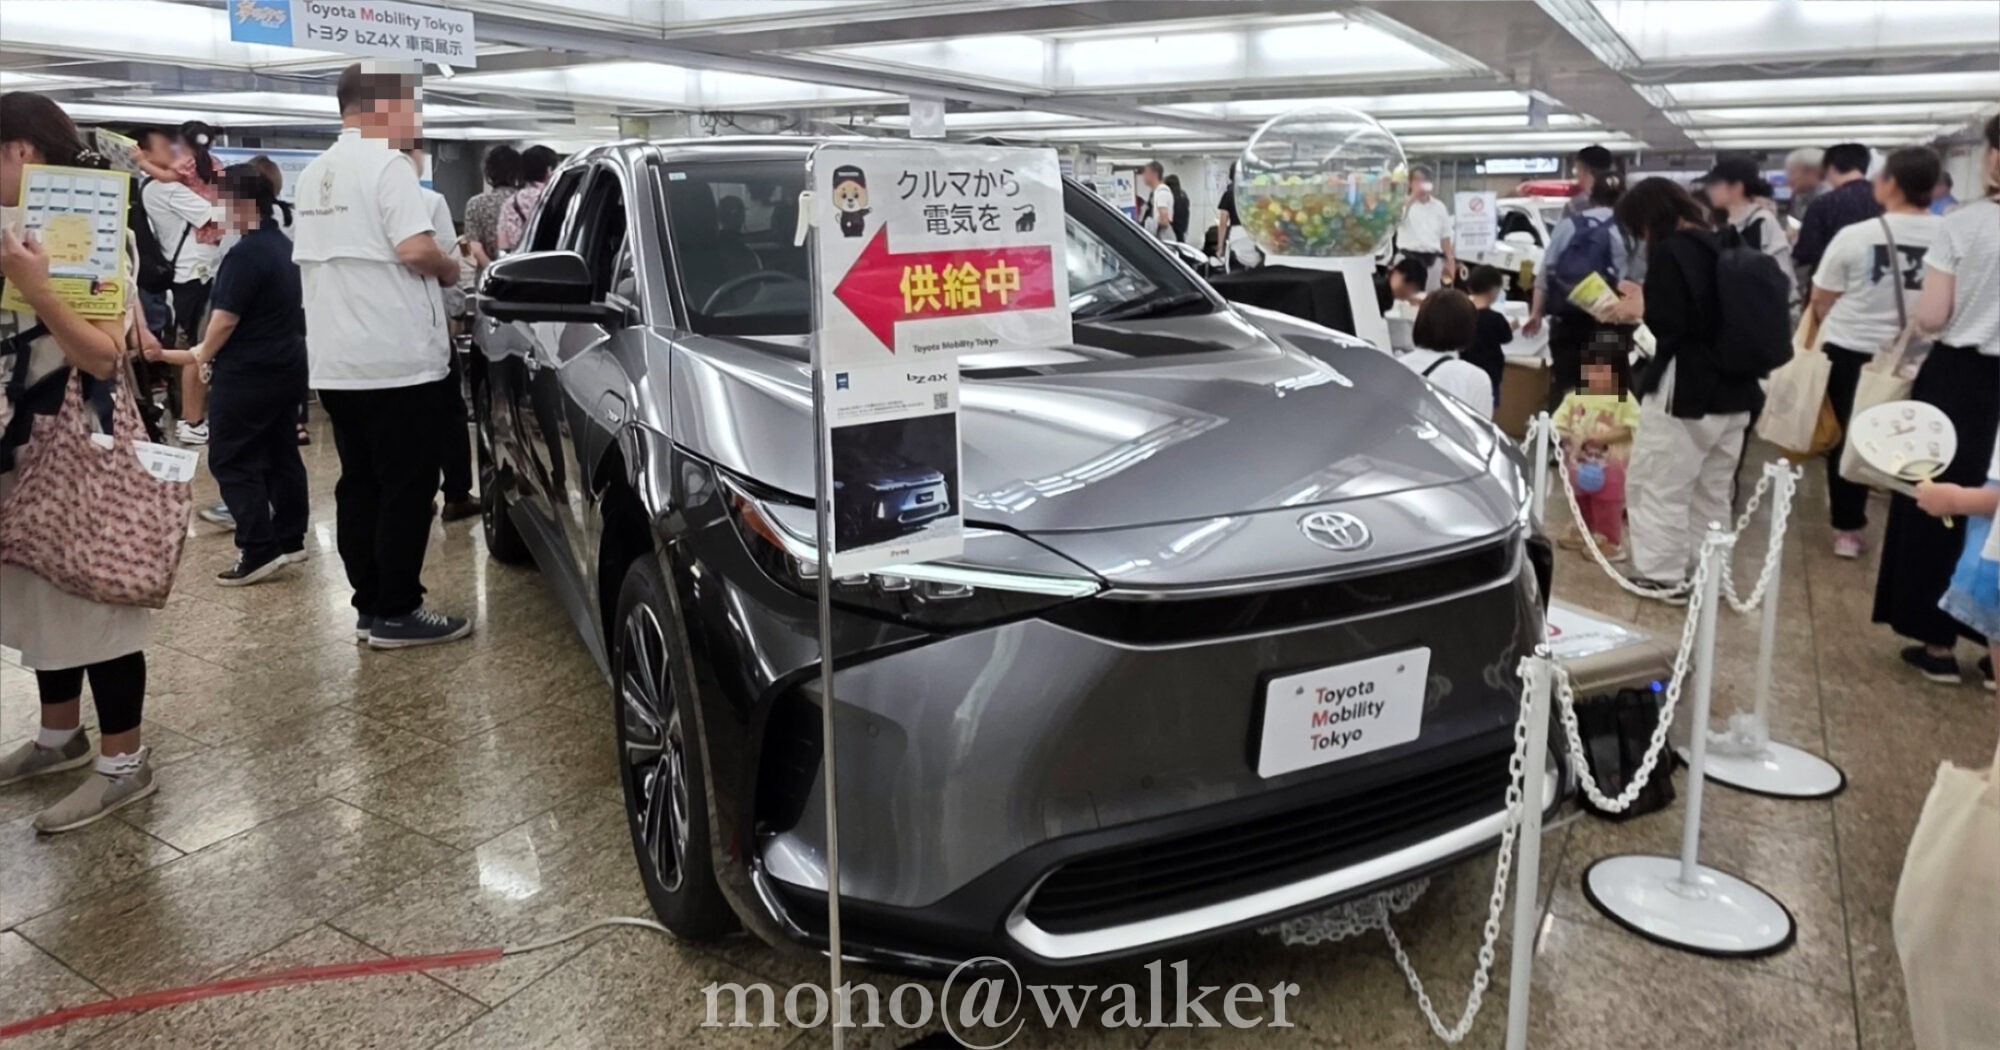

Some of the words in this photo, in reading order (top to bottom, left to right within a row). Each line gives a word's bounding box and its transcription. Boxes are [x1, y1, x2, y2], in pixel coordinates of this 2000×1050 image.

[304, 0, 355, 19] Toyota
[360, 7, 420, 29] Mobility
[423, 16, 463, 35] Tokyo
[306, 22, 349, 42] トヨタ
[355, 31, 400, 49] bZ4X
[406, 35, 462, 55] 車両展示
[897, 168, 1020, 200] クルマから
[923, 203, 1001, 235] 電気を
[899, 259, 1020, 313] 供給中
[1315, 681, 1374, 705] Toyota
[1311, 701, 1384, 728] Mobility
[1310, 728, 1362, 751] Tokyo
